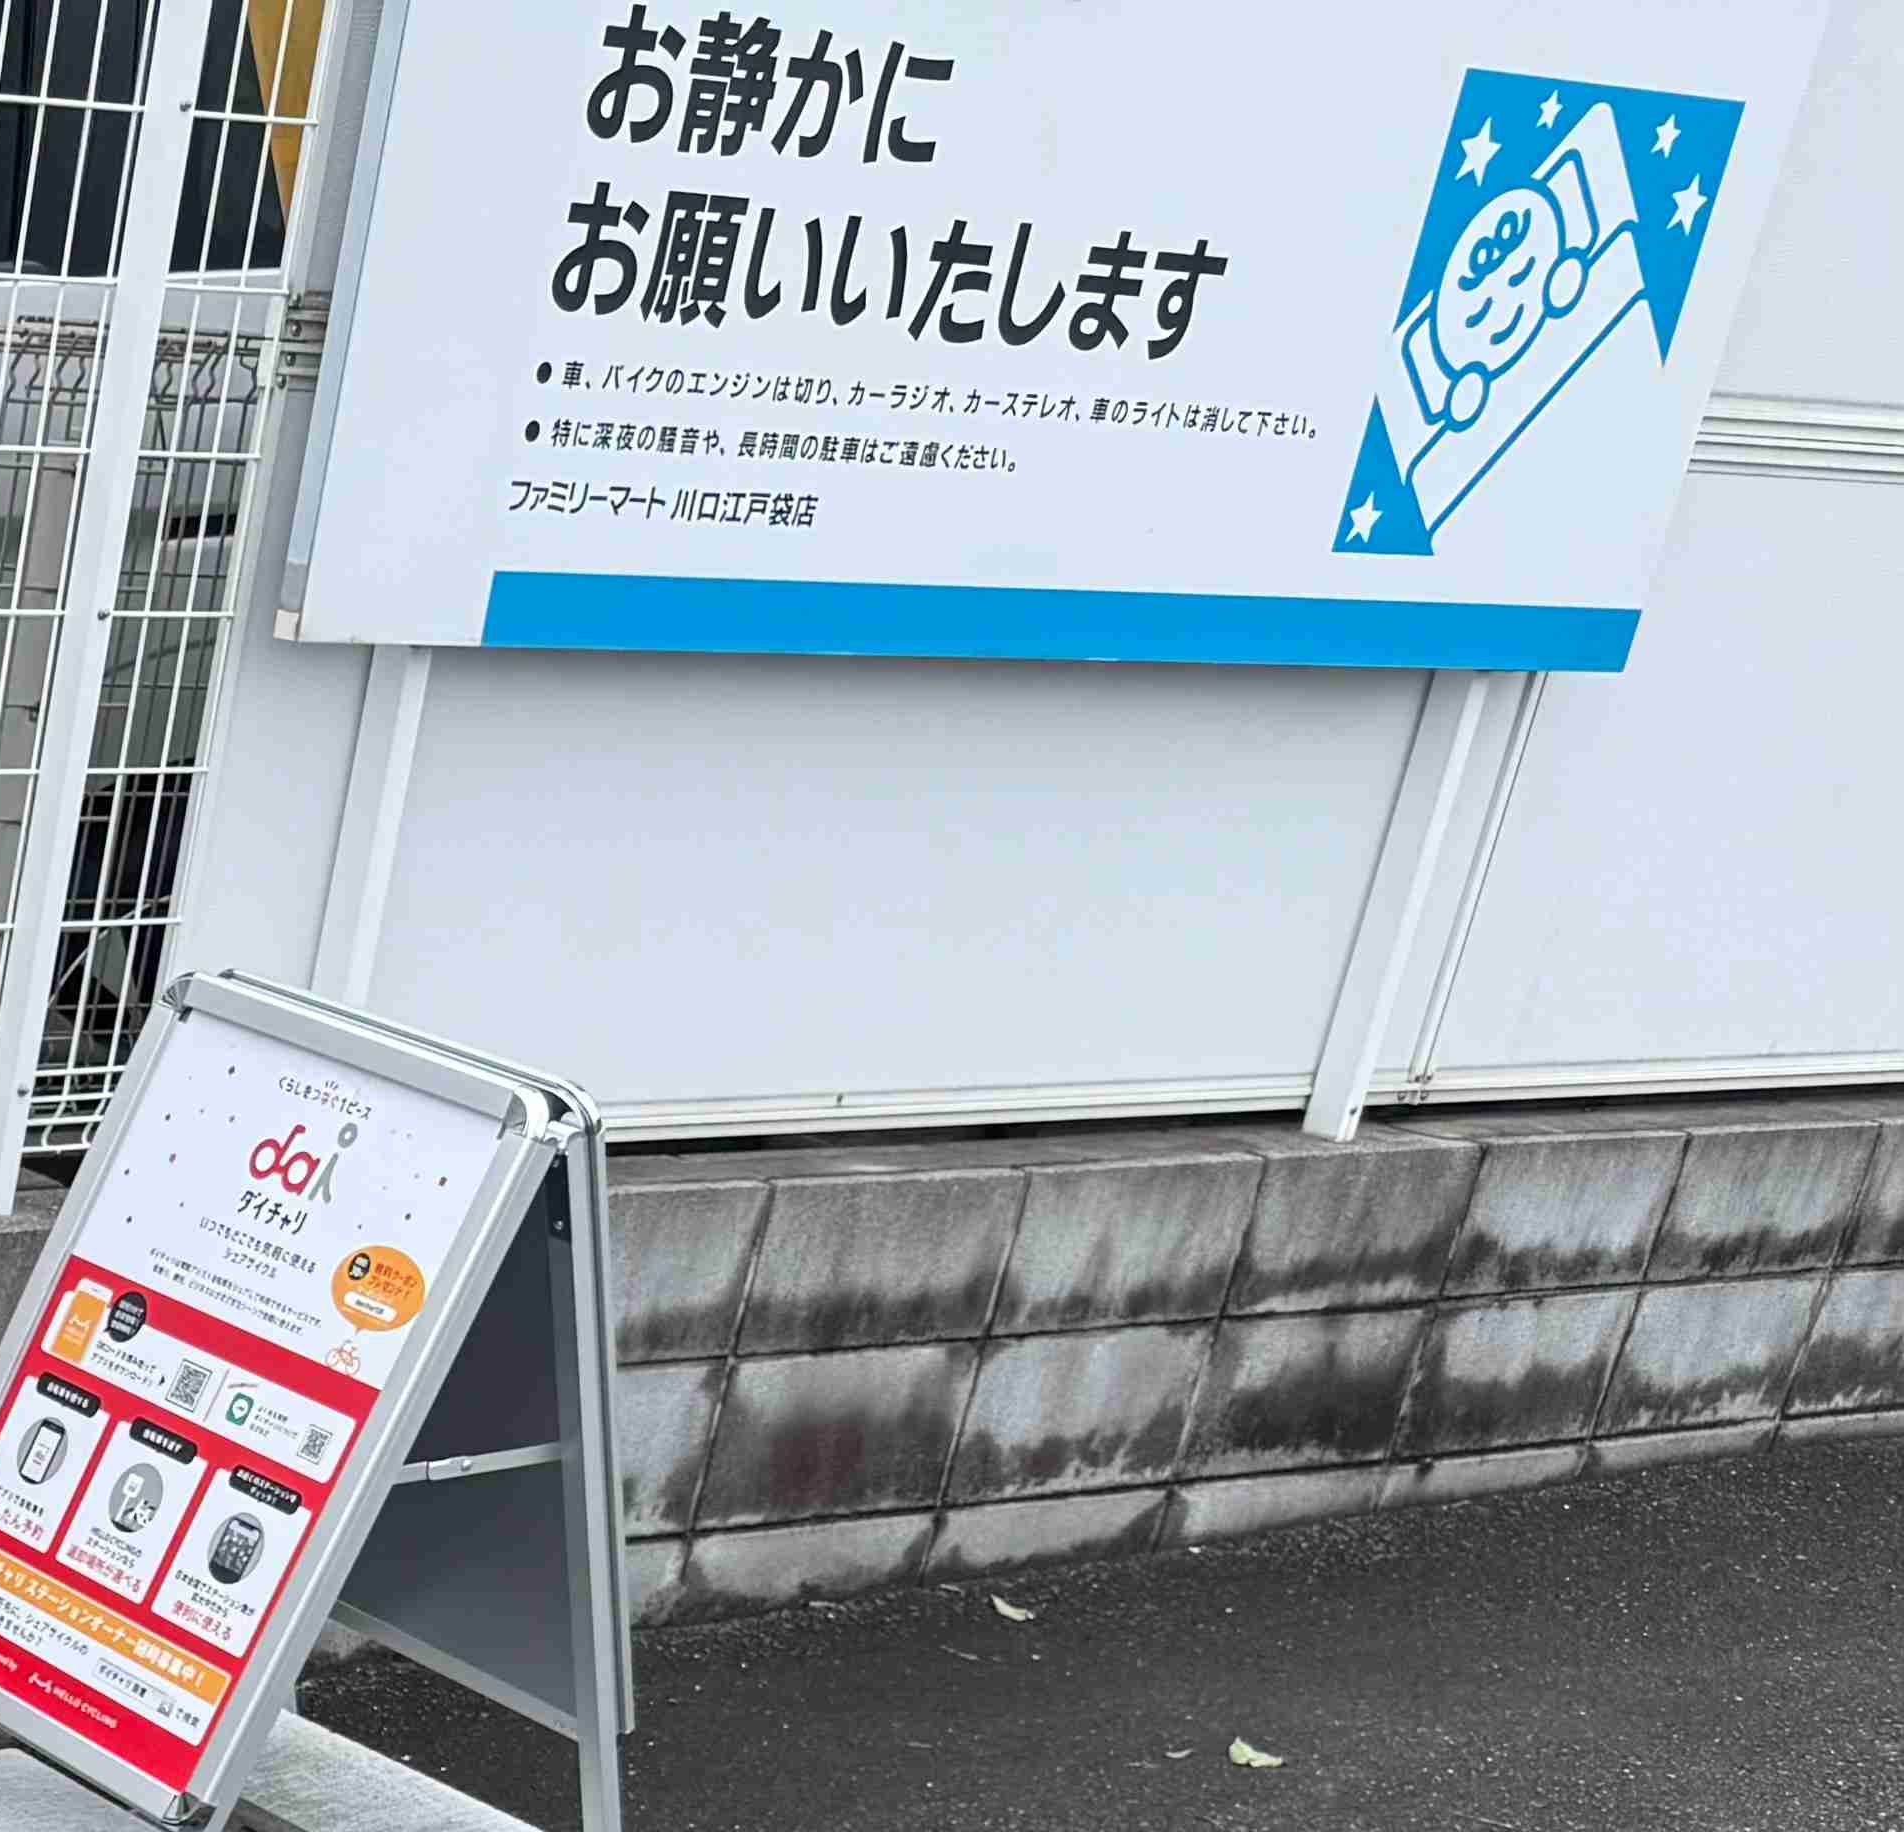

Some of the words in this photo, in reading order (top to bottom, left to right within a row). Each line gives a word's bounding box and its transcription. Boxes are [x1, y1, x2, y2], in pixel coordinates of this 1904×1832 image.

[585, 4, 954, 164] お静かに
[550, 181, 1228, 361] お願いいたします
[509, 480, 667, 519] ファミリーマート
[670, 487, 819, 528] 川口江戸袋店
[237, 1190, 307, 1234] ダイチャリ
